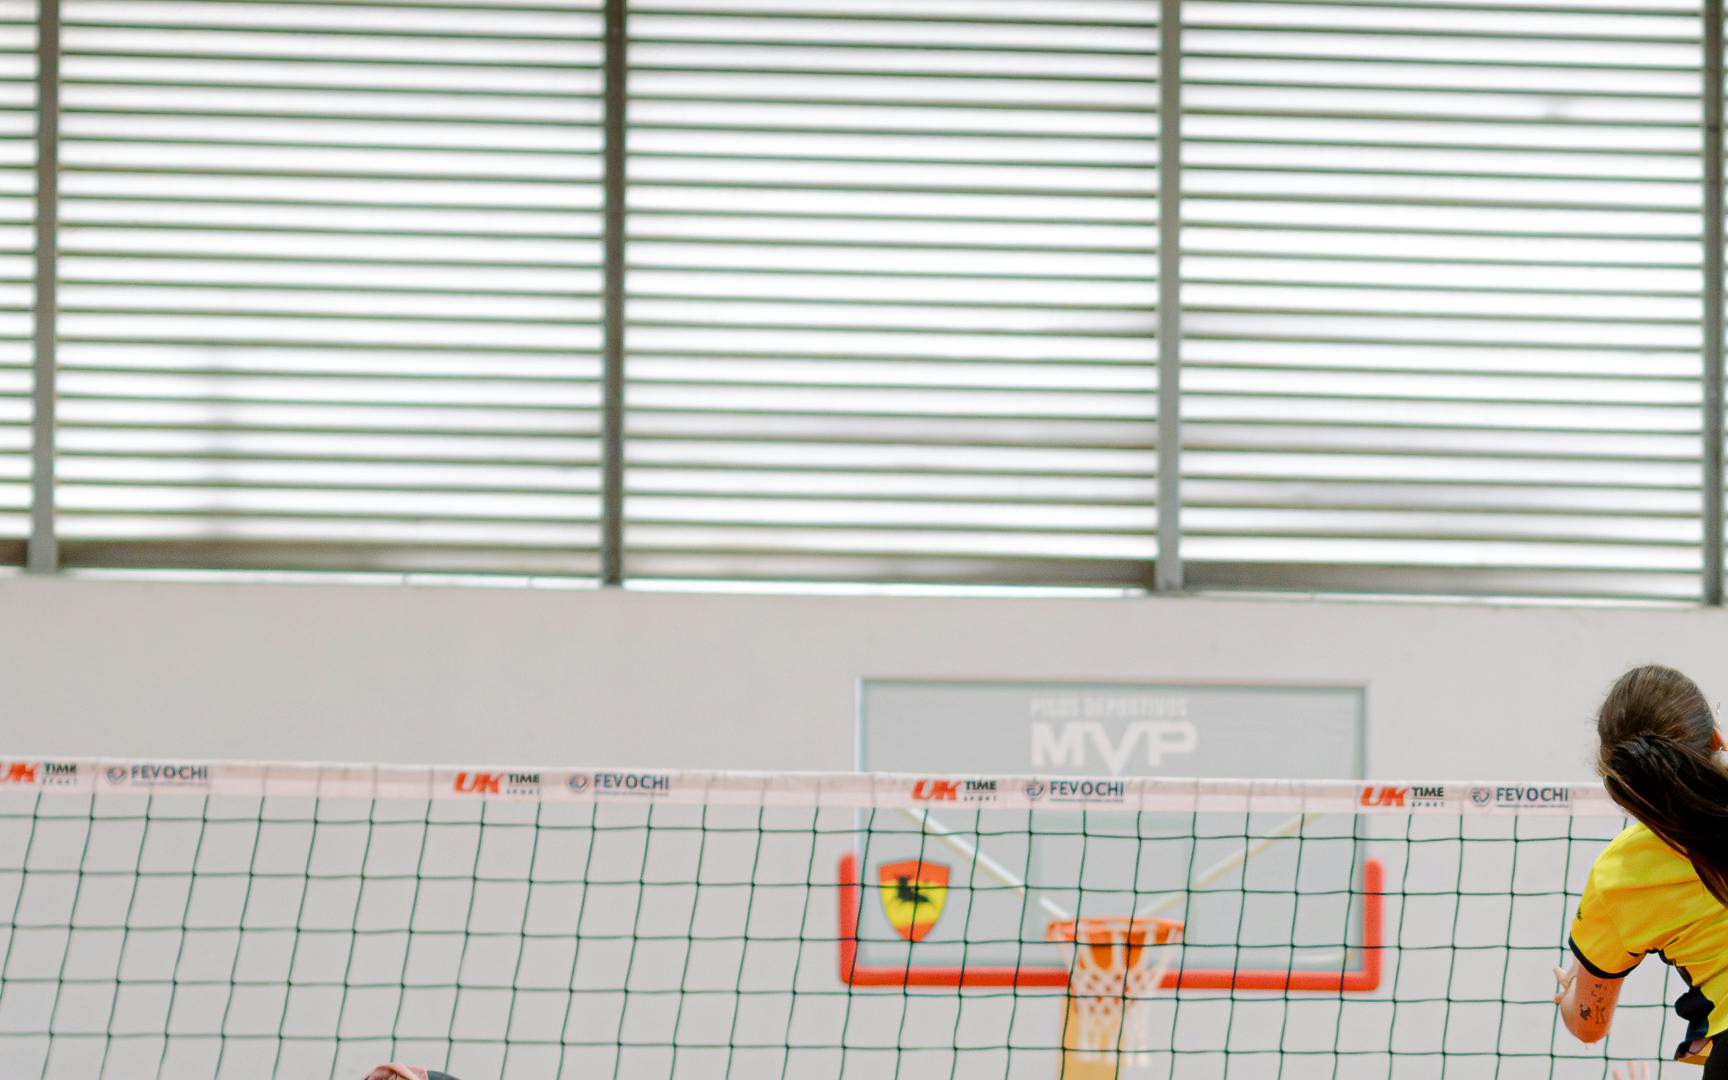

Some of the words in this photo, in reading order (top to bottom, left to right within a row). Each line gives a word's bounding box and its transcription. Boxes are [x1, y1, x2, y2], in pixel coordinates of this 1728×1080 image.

[1031, 721, 1197, 776] MVP
[131, 765, 208, 779] FEVOCHI
[508, 773, 540, 783] TIME
[594, 773, 669, 790] FEVOCHI
[966, 780, 996, 790] TIME
[1050, 781, 1124, 796] FEVOCHI
[1360, 787, 1409, 807] UK
[1412, 787, 1443, 797] TIME
[1496, 787, 1568, 801] FEVOCHI
